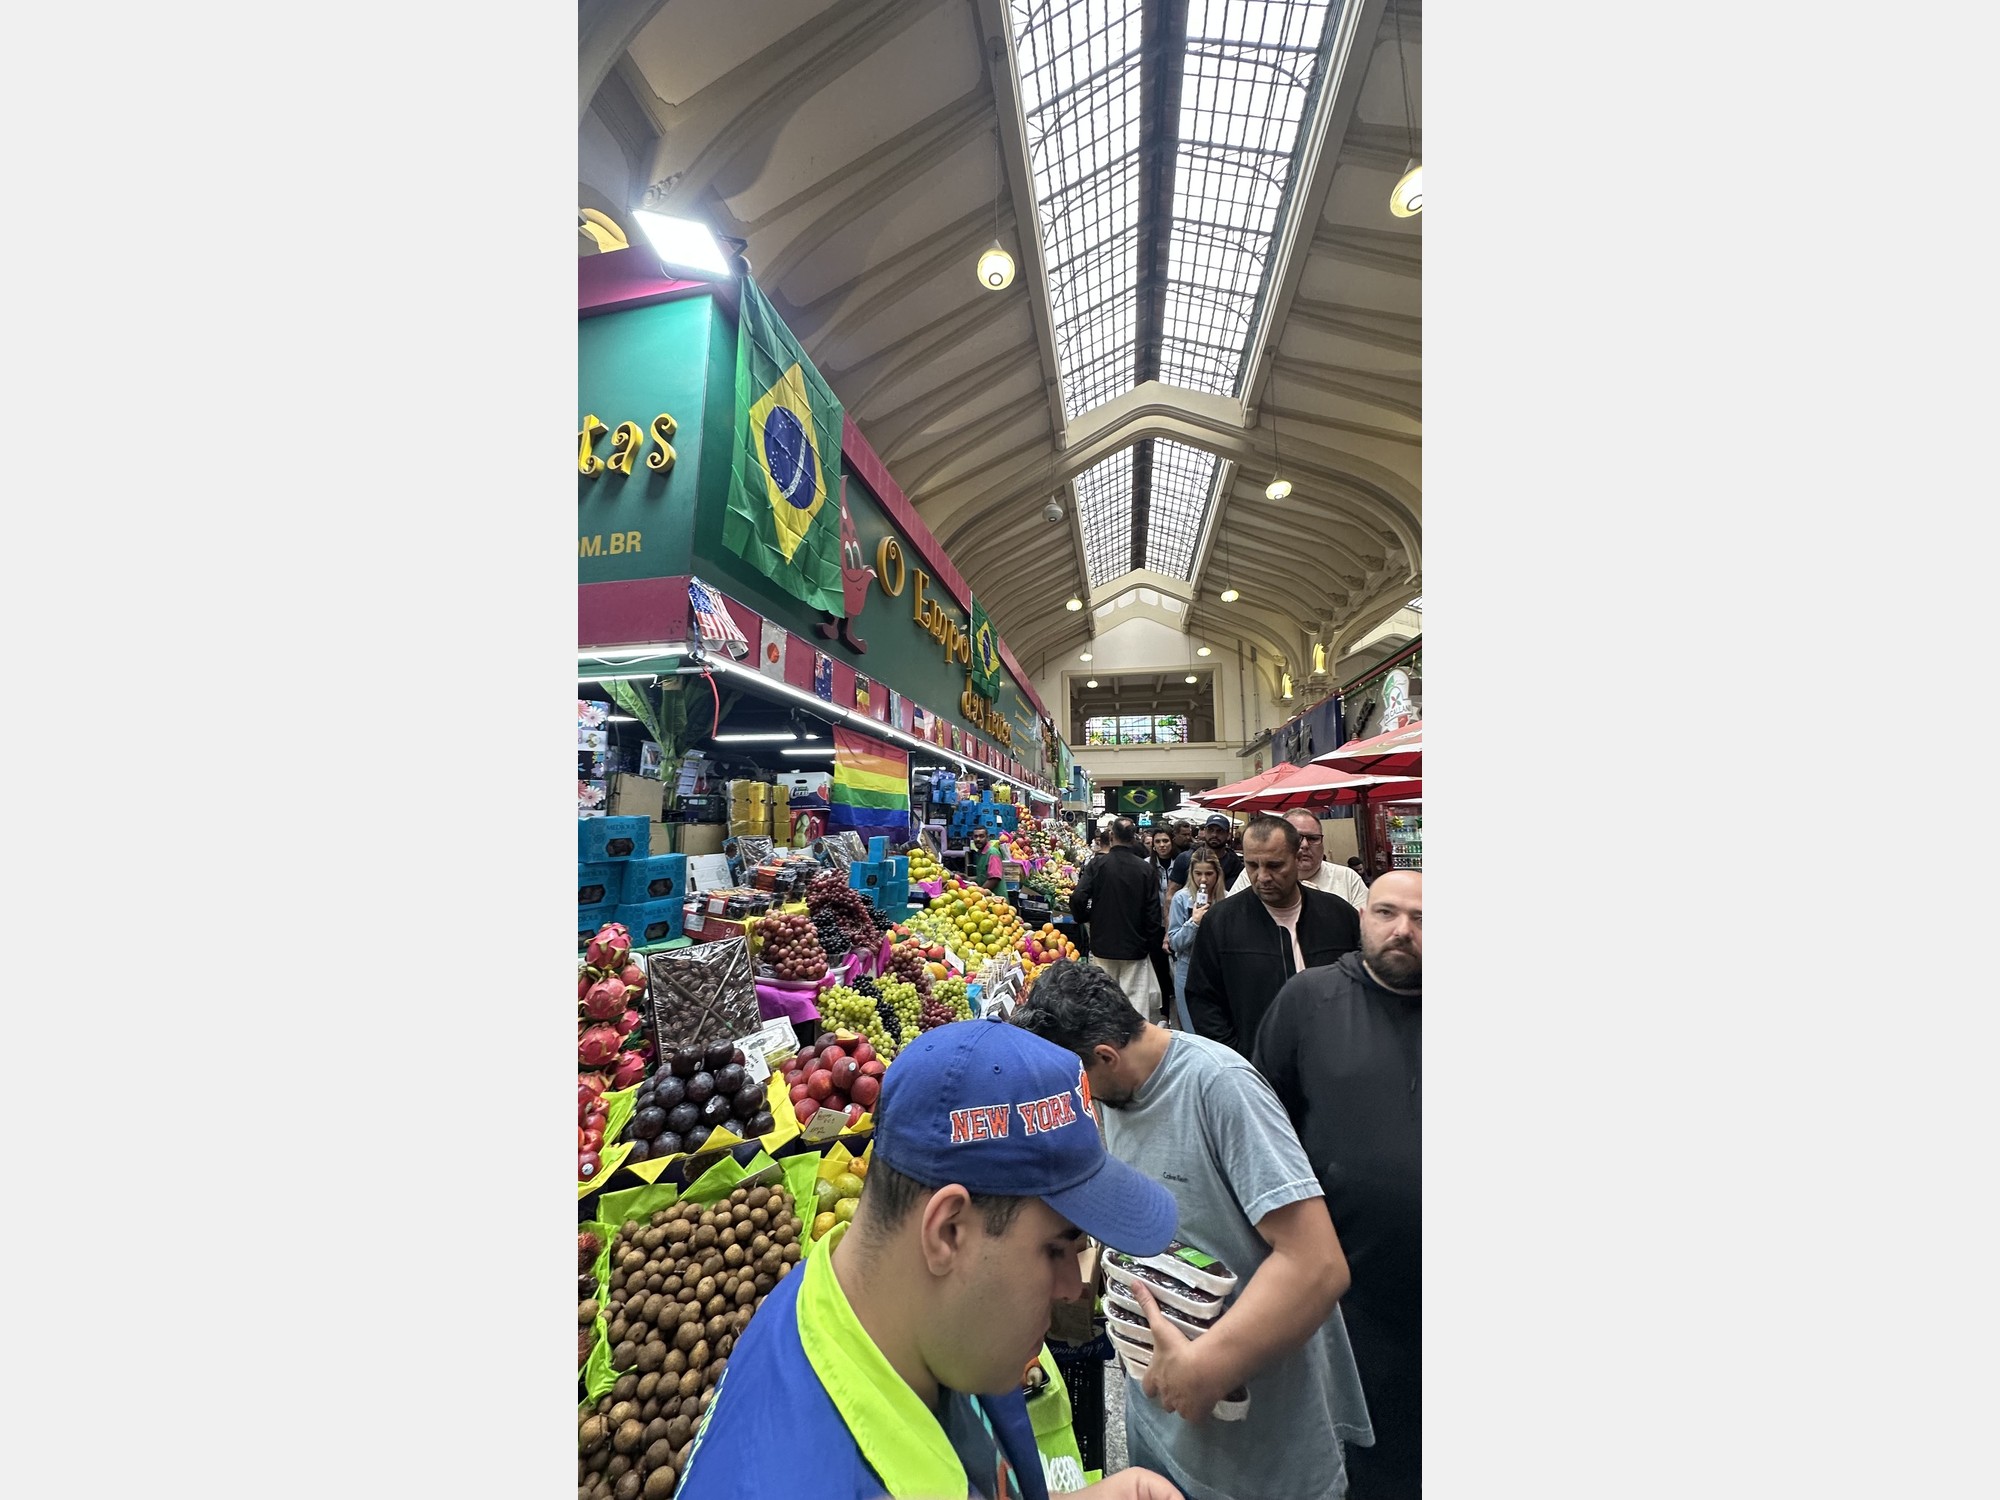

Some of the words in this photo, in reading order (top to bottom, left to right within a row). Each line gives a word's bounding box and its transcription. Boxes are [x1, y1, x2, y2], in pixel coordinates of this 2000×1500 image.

[578, 531, 642, 558] M.BR
[877, 535, 906, 597] O
[950, 1104, 1010, 1143] NEW
[1016, 1091, 1077, 1136] YORK
